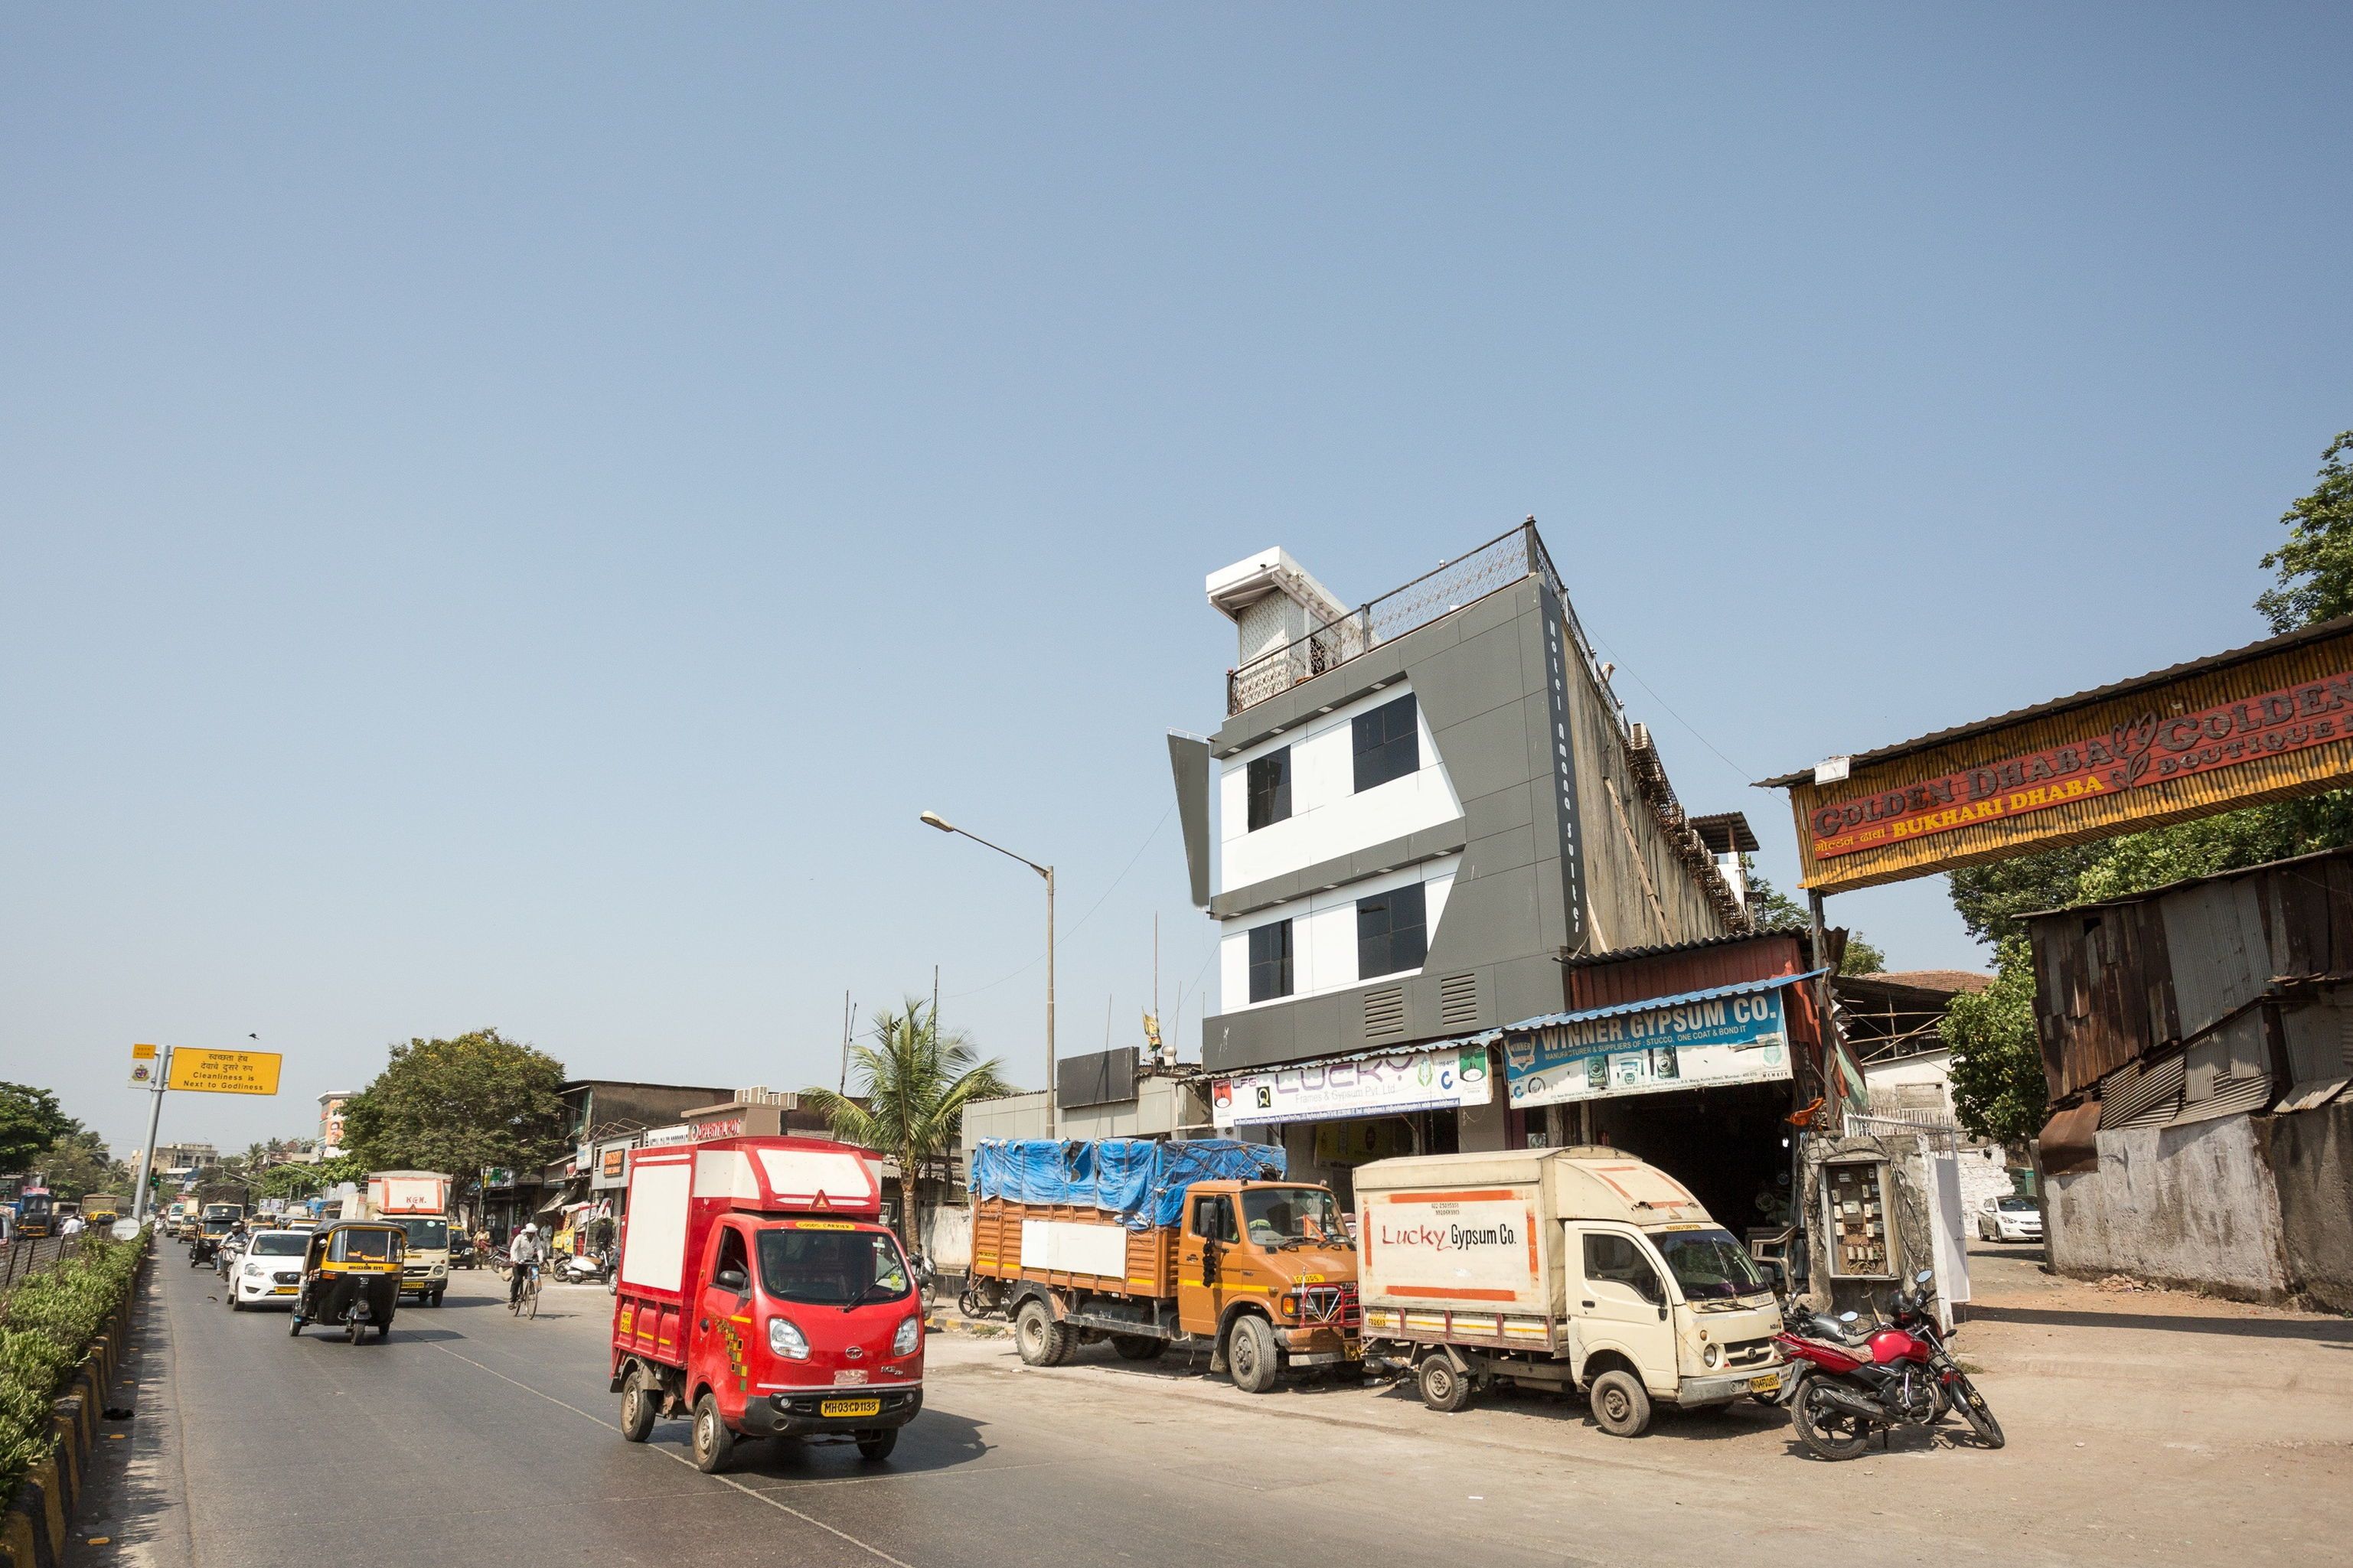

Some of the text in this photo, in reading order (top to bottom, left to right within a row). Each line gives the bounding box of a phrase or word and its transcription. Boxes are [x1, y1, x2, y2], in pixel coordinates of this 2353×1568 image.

[1549, 620, 1561, 710] Hotel
[2159, 719, 2335, 776] BOUTIQUE
[1815, 741, 2114, 837] GOLDEN DHABA
[1891, 776, 2105, 838] BUKHARI DHABA
[1859, 827, 1885, 843] ढाबा
[1540, 996, 1777, 1051] WINNER GYPSUM CO.
[1510, 1042, 1531, 1052] WINNER
[1545, 1048, 1591, 1060] MANUFACTURER
[1598, 1042, 1632, 1052] SUPPLIERS
[1677, 1033, 1692, 1042] ONE
[1693, 1030, 1711, 1039] COAT
[1718, 1026, 1739, 1035] BOND
[193, 1072, 243, 1081] Cleanliness
[220, 1082, 263, 1090] Godliness
[1275, 1055, 1415, 1094] LUCKY
[1295, 1093, 1322, 1104] Frames
[1324, 1091, 1330, 1101] &
[1331, 1087, 1363, 1102] Gypsum
[1382, 1223, 1517, 1252] Lucky Gypsum Co.
